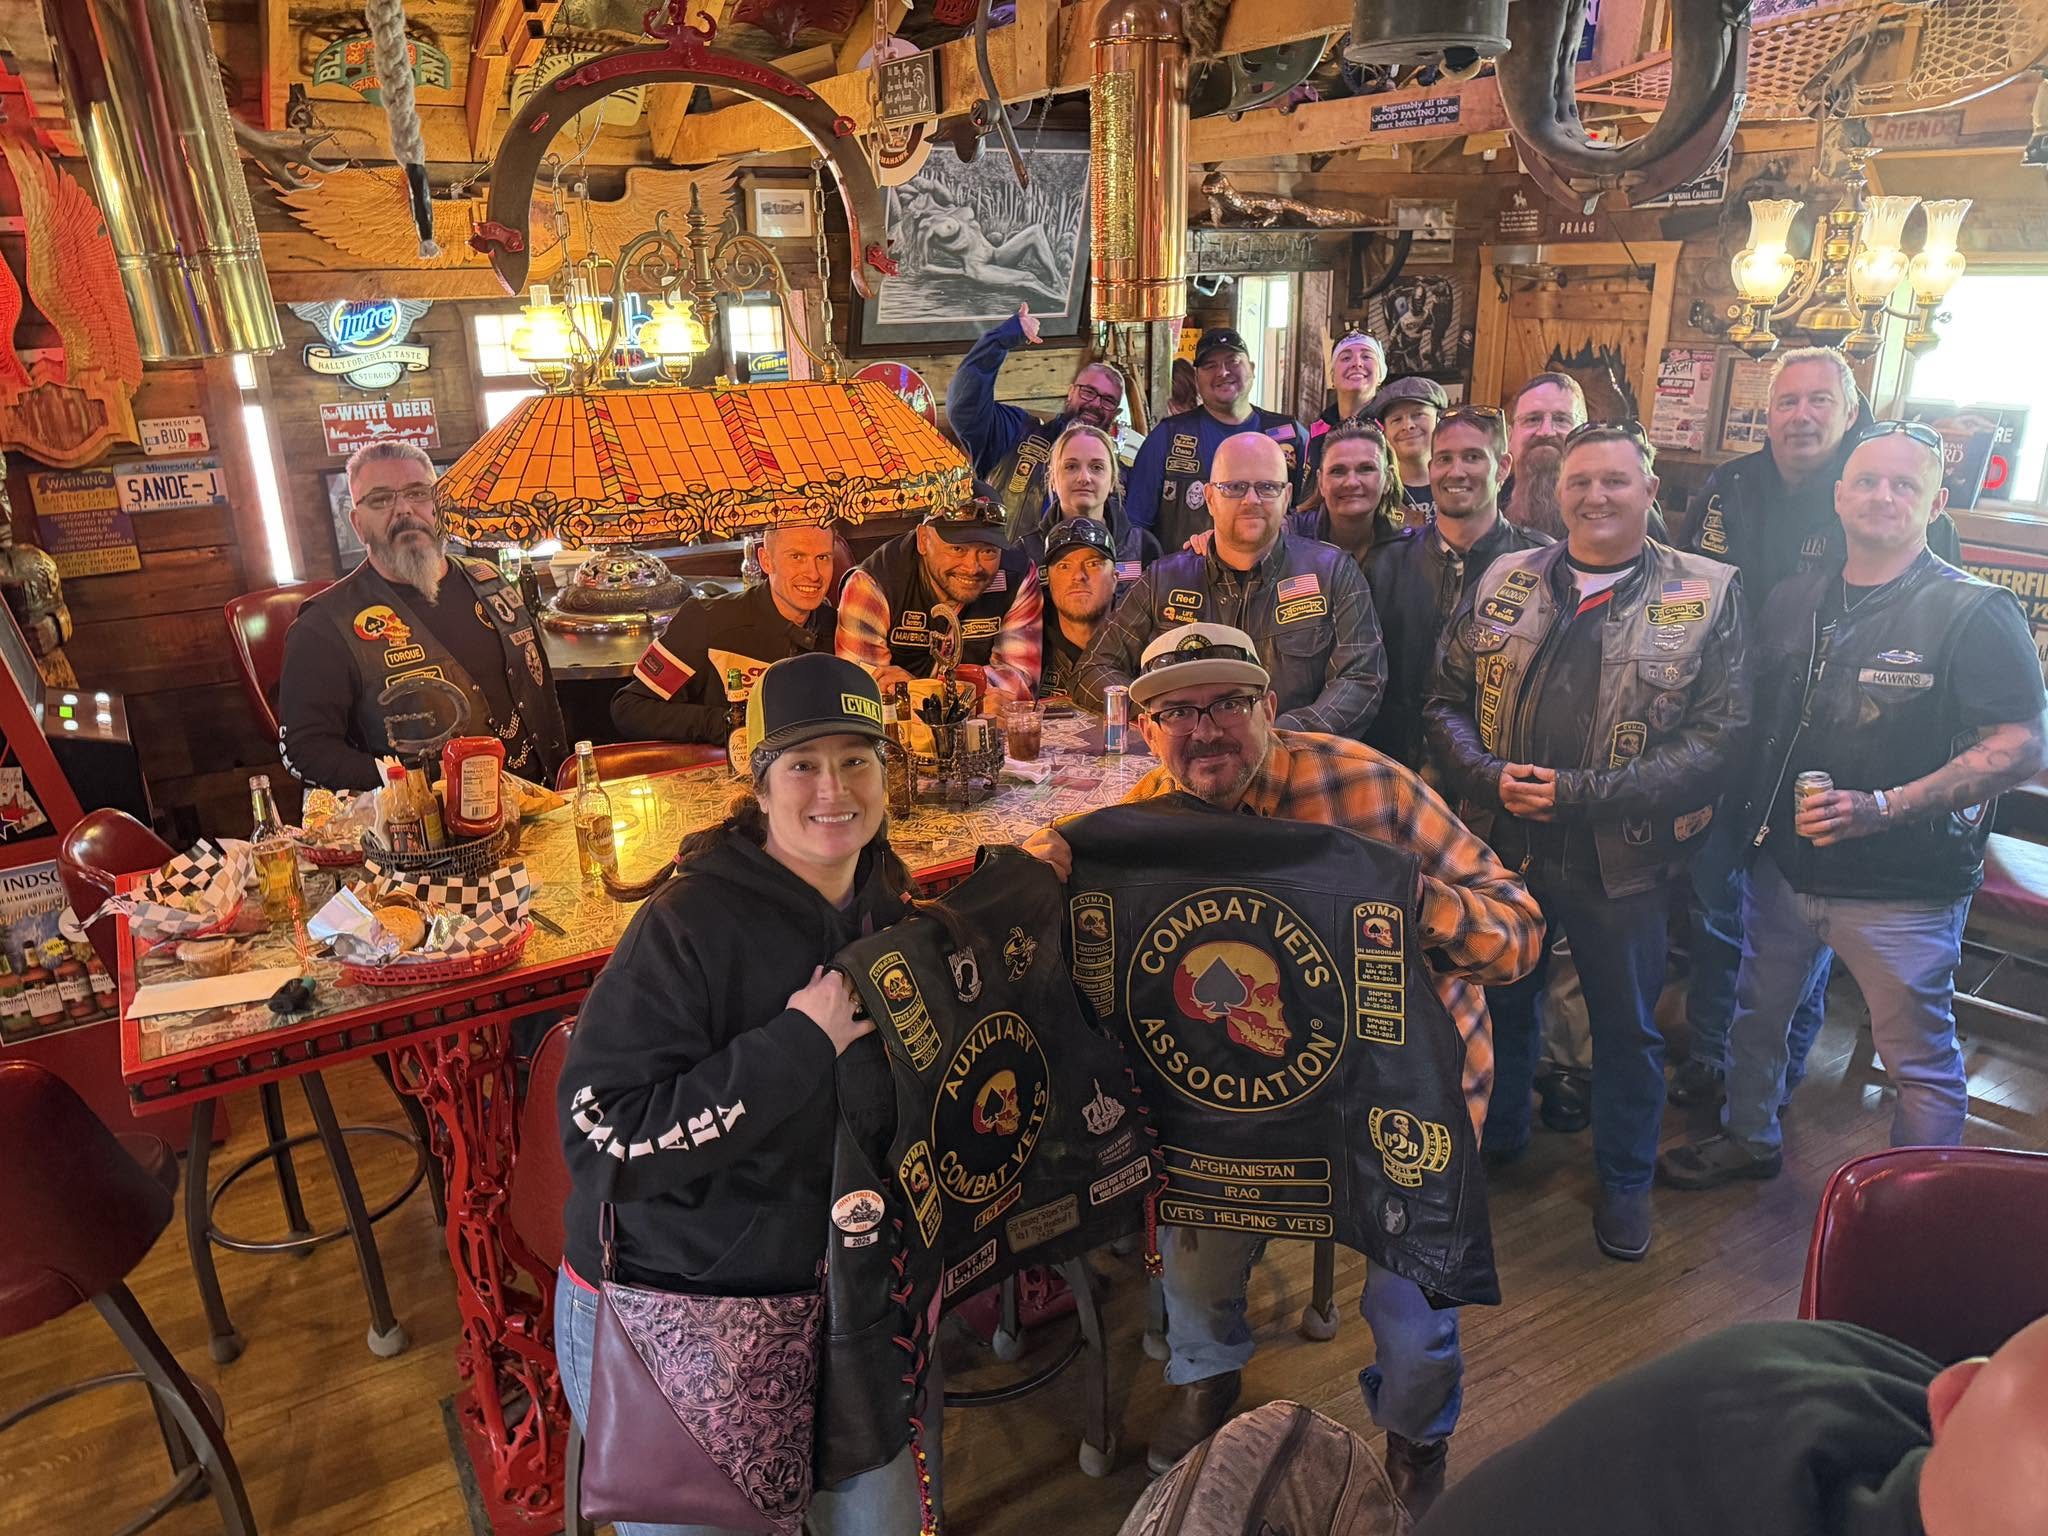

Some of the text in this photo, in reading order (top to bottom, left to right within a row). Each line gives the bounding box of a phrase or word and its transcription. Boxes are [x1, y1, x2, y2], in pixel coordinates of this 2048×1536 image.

[1372, 105, 1459, 122] GOOD PAYING JOBS
[1382, 101, 1422, 112] Regrettably
[1425, 99, 1434, 107] all
[1395, 119, 1417, 128] before
[1424, 117, 1436, 125] get
[1560, 221, 1595, 234] PRAAG
[338, 306, 395, 344] Lite
[318, 359, 346, 370] RALLY
[365, 352, 392, 364] GREAT
[395, 351, 421, 360] TASTE
[337, 403, 387, 421] WHITE
[393, 401, 432, 416] DEER
[161, 428, 187, 444] BUD
[1994, 427, 2014, 443] RE
[1944, 449, 1963, 463] RD
[145, 462, 196, 472] Minnesota
[47, 475, 108, 489] WARNING
[127, 472, 218, 503] SANDE-J
[1968, 566, 2048, 598] STERFI
[1176, 594, 1195, 604] Red
[1665, 606, 1686, 614] CVMA
[895, 631, 928, 643] MAVERICK
[387, 648, 422, 663] TORQUE
[1873, 671, 1920, 686] HAWKINS
[846, 698, 878, 719] CVMA
[3, 871, 59, 892] INDS
[1079, 896, 1104, 904] CVMA
[1357, 905, 1398, 921] CVMA
[1078, 944, 1110, 953] NATIONAL
[1141, 897, 1330, 988] COMBAT VETS
[1365, 948, 1401, 956] MEMORIAM
[1368, 990, 1392, 998] SNIPES
[906, 1019, 923, 1037] 2023
[1366, 1017, 1394, 1026] SPARKS
[913, 1034, 930, 1051] 2024
[945, 1018, 1034, 1100] AUXILIARY
[1139, 1019, 1336, 1103] ASSOCIATION
[940, 1089, 1046, 1196] COMBAT VETS
[1427, 1132, 1436, 1161] 2020
[1440, 1135, 1448, 1161] 2021
[902, 1145, 925, 1178] CVMA
[1190, 1159, 1295, 1178] AFGHANISTAN
[1093, 1182, 1108, 1193] NEVER
[1134, 1161, 1146, 1174] THAN
[1126, 1177, 1136, 1188] CAN
[1135, 1171, 1144, 1182] FLY
[1224, 1185, 1260, 1200] IRAQ
[1167, 1206, 1326, 1231] VETS HELPING VETS
[852, 1236, 871, 1247] 2025
[980, 1245, 992, 1259] MY
[954, 1256, 993, 1286] SOLDIER
